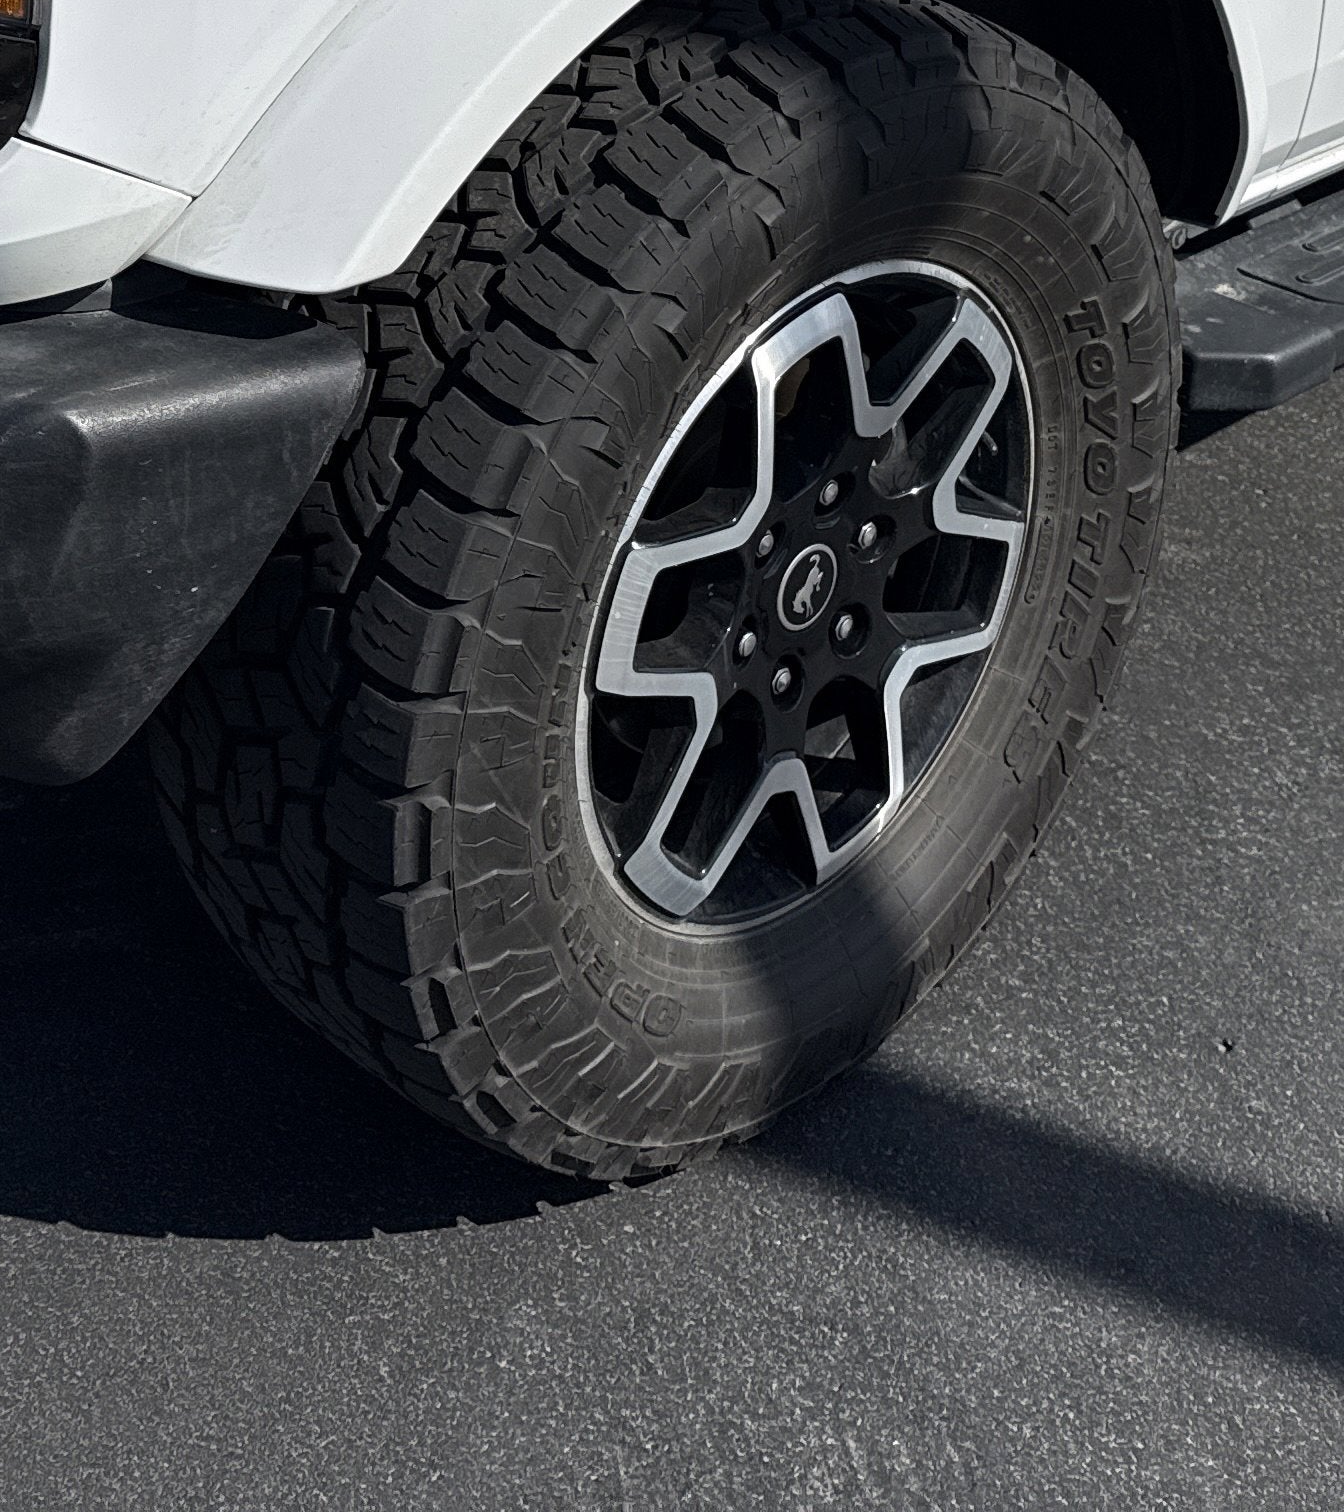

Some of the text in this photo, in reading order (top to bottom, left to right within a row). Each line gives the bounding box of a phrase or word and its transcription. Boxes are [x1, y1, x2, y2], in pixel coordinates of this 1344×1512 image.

[1003, 294, 1120, 786] TOYO TIRES
[560, 908, 682, 1039] OPEN
